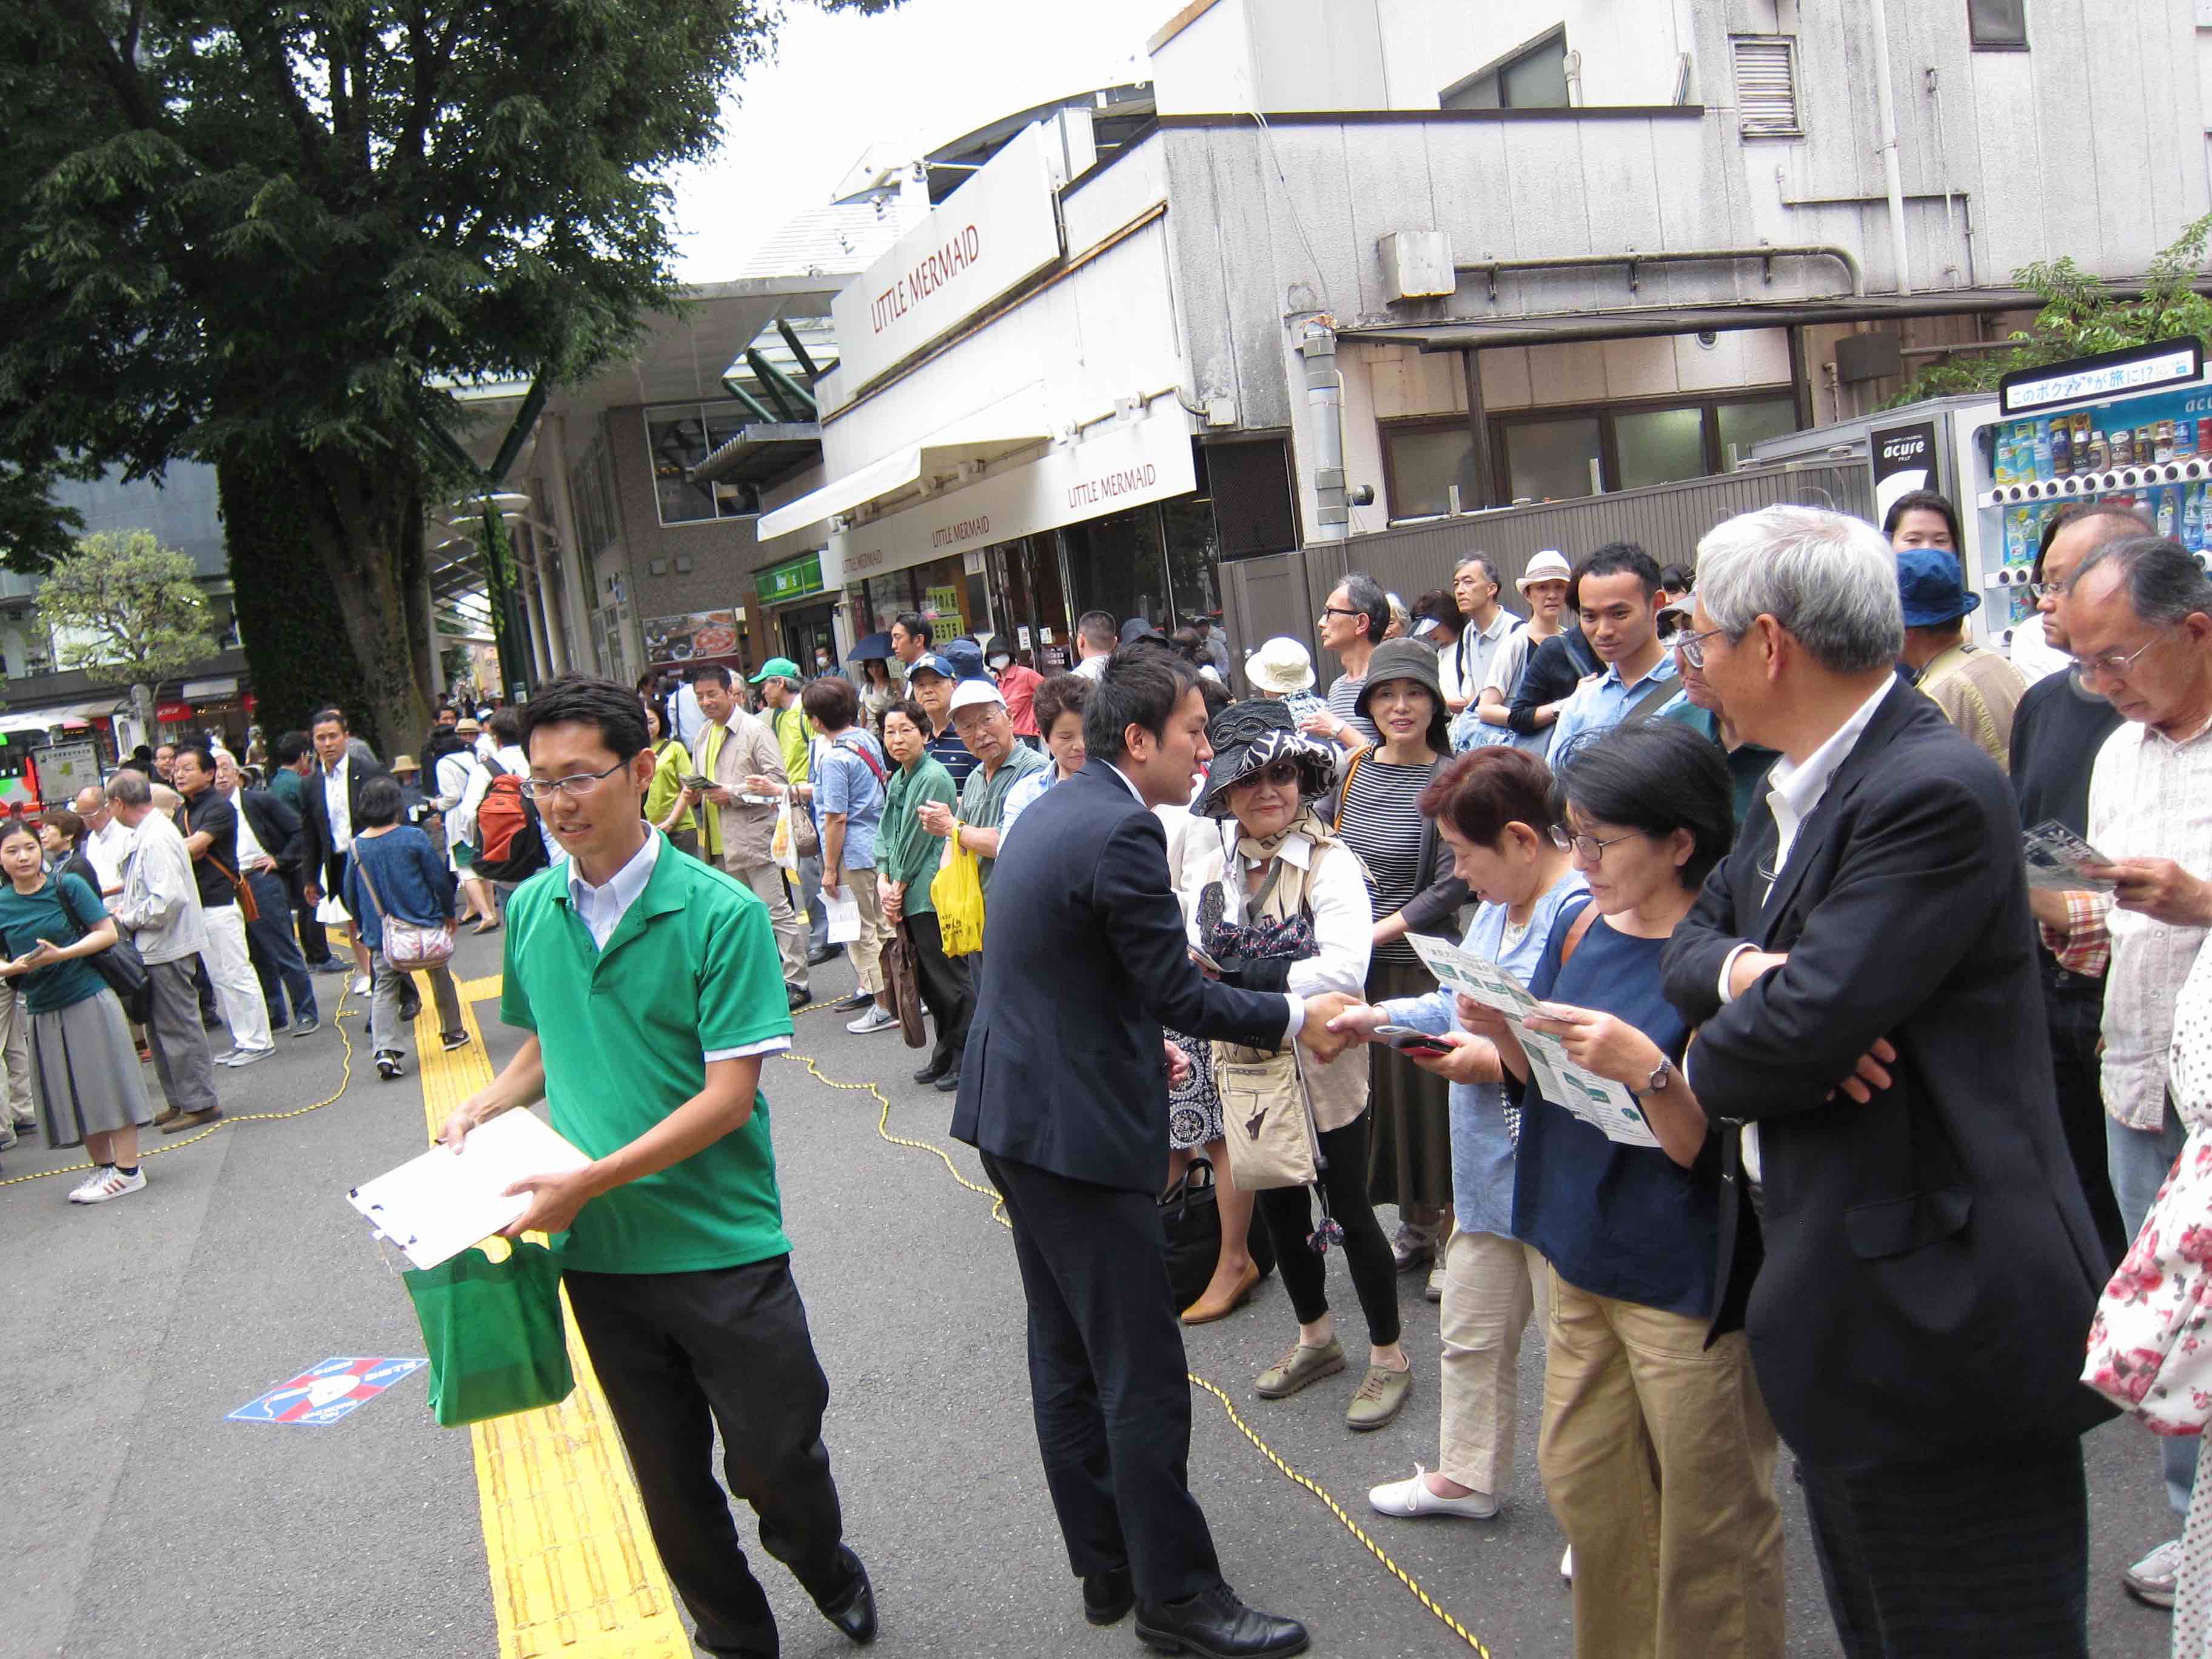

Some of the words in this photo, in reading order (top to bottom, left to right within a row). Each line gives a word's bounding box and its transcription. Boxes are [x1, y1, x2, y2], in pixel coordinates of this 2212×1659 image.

[871, 281, 907, 334] LITTLE
[908, 224, 979, 307] MERMAID
[1883, 441, 1925, 458] acure
[1067, 481, 1099, 508] LITTLE
[1101, 464, 1156, 499] MERMAID
[932, 526, 953, 548] LITTLE
[954, 516, 989, 543] MERMAID
